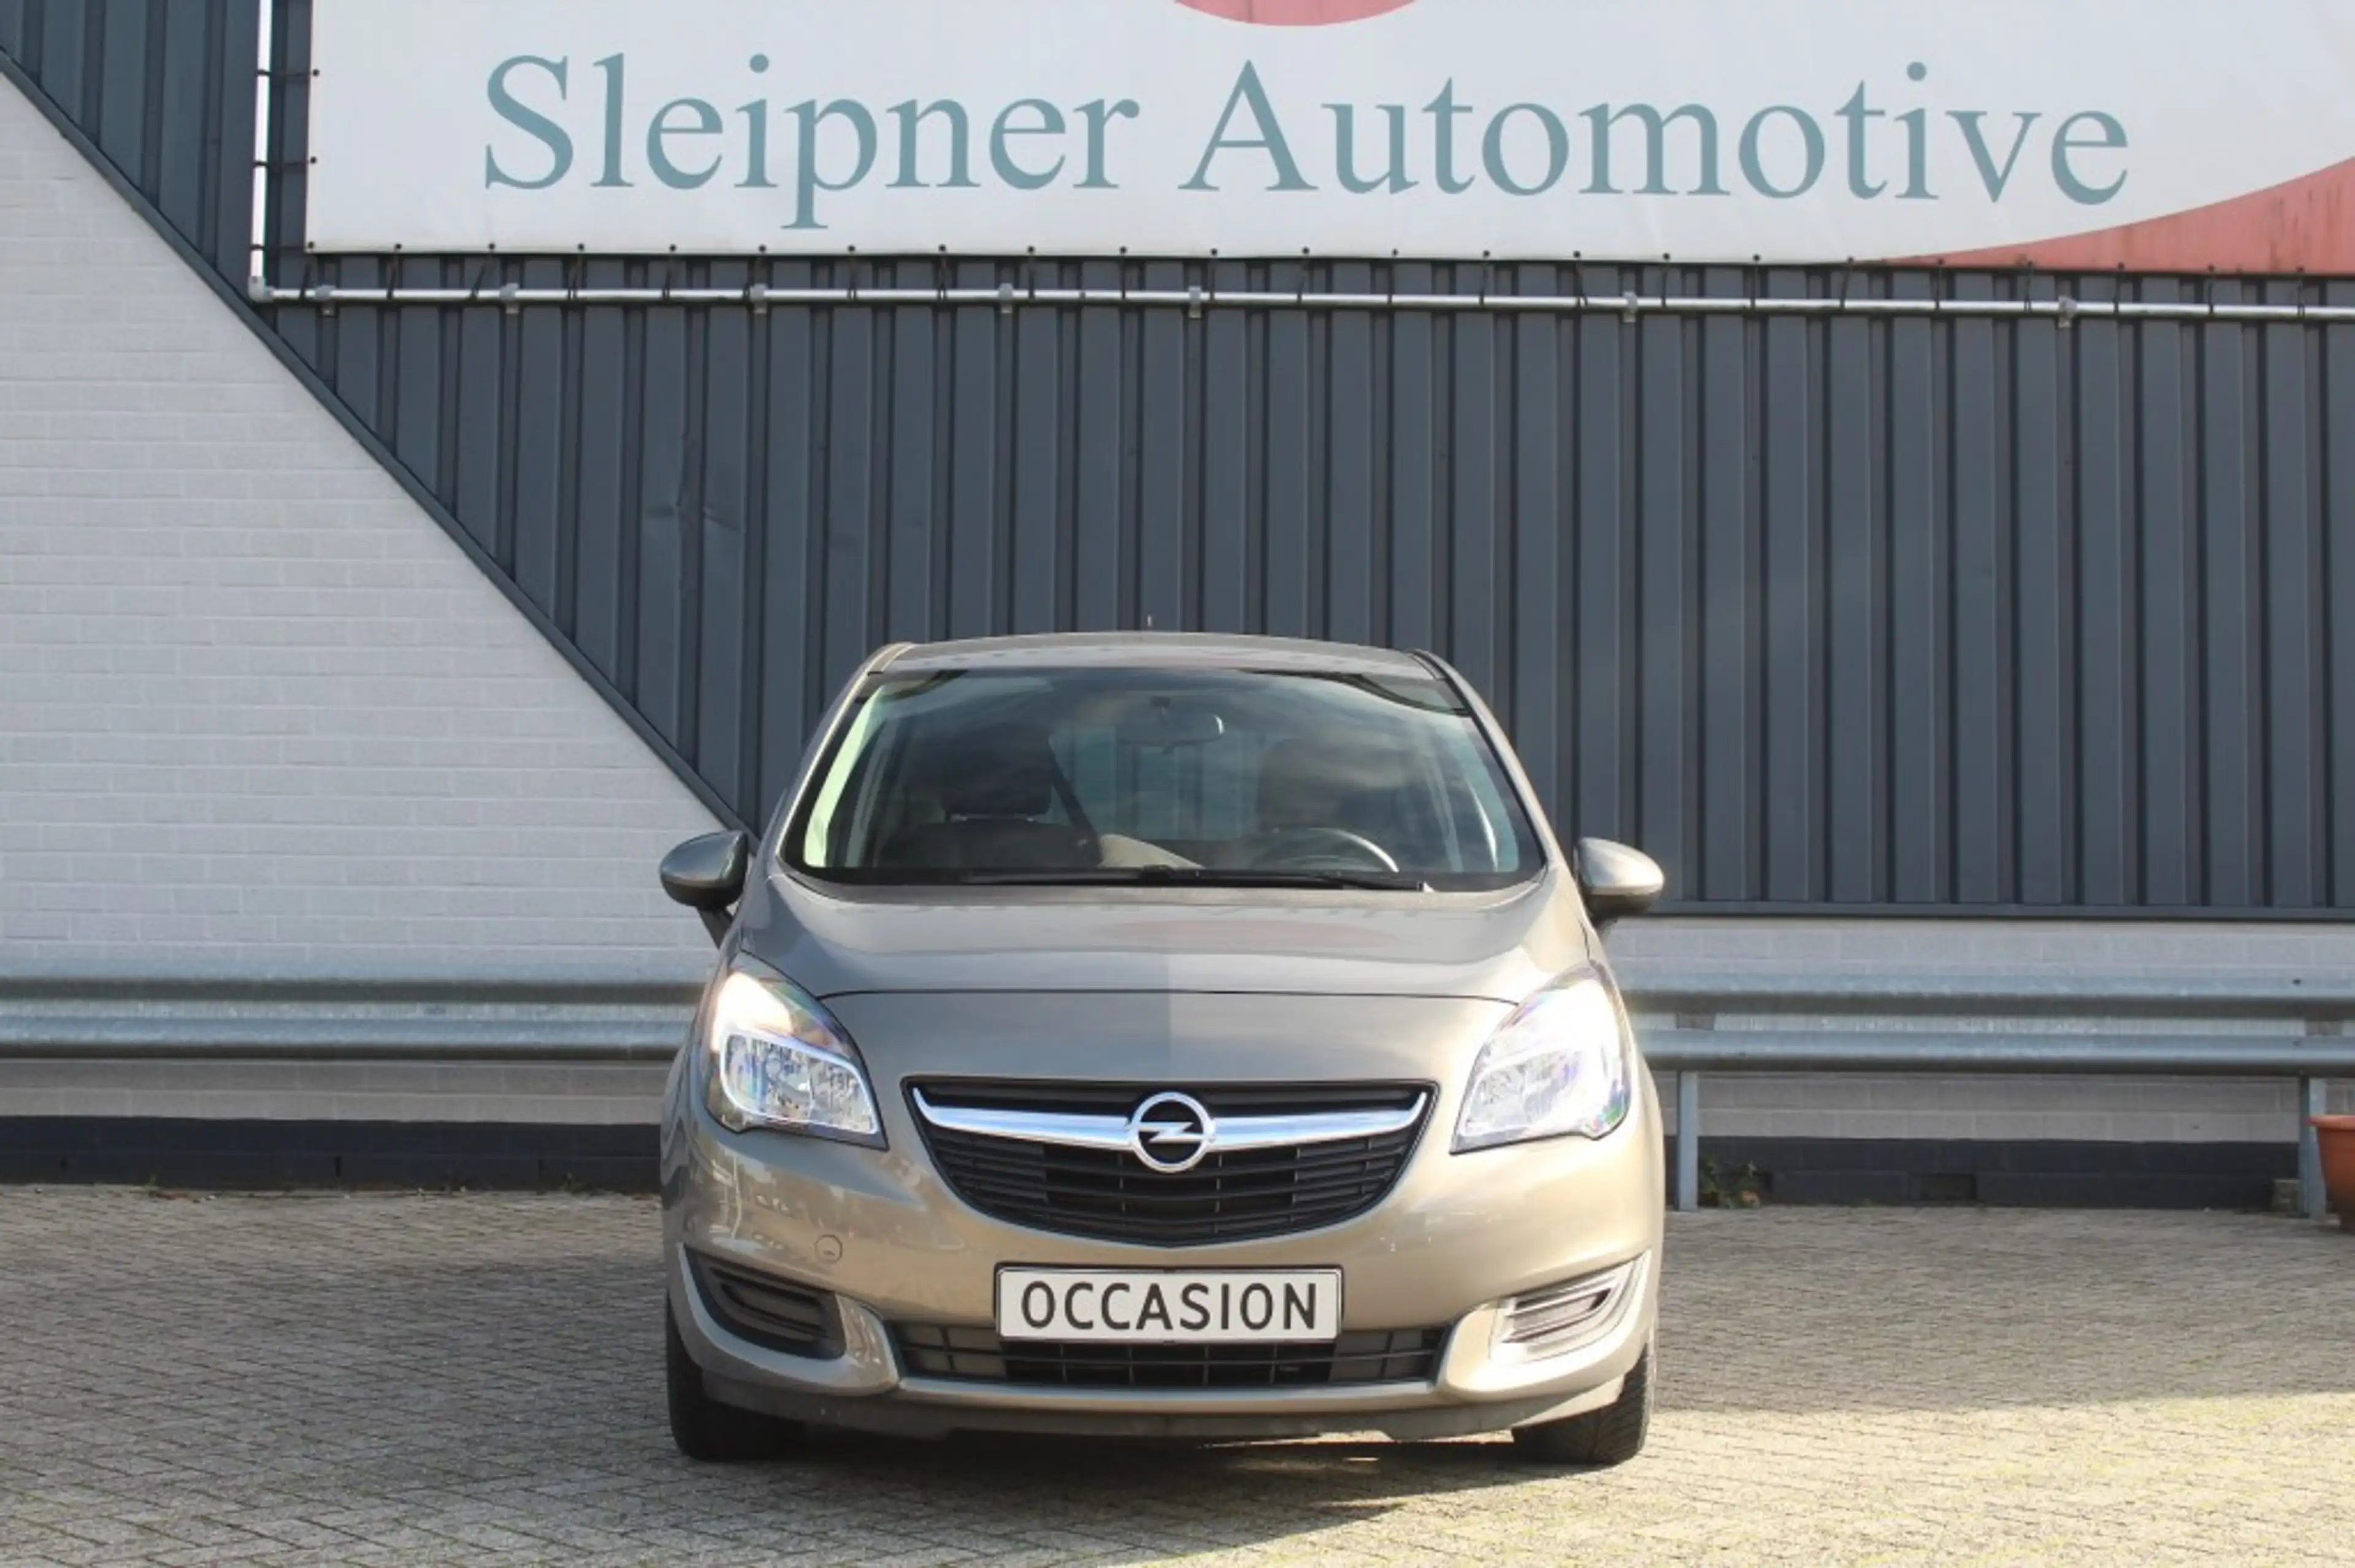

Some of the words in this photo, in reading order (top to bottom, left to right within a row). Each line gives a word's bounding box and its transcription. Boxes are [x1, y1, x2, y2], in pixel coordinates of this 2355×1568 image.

[484, 52, 1141, 230] Sleipner
[1178, 59, 2129, 206] Automotive
[1020, 1280, 1317, 1331] OCCASION
